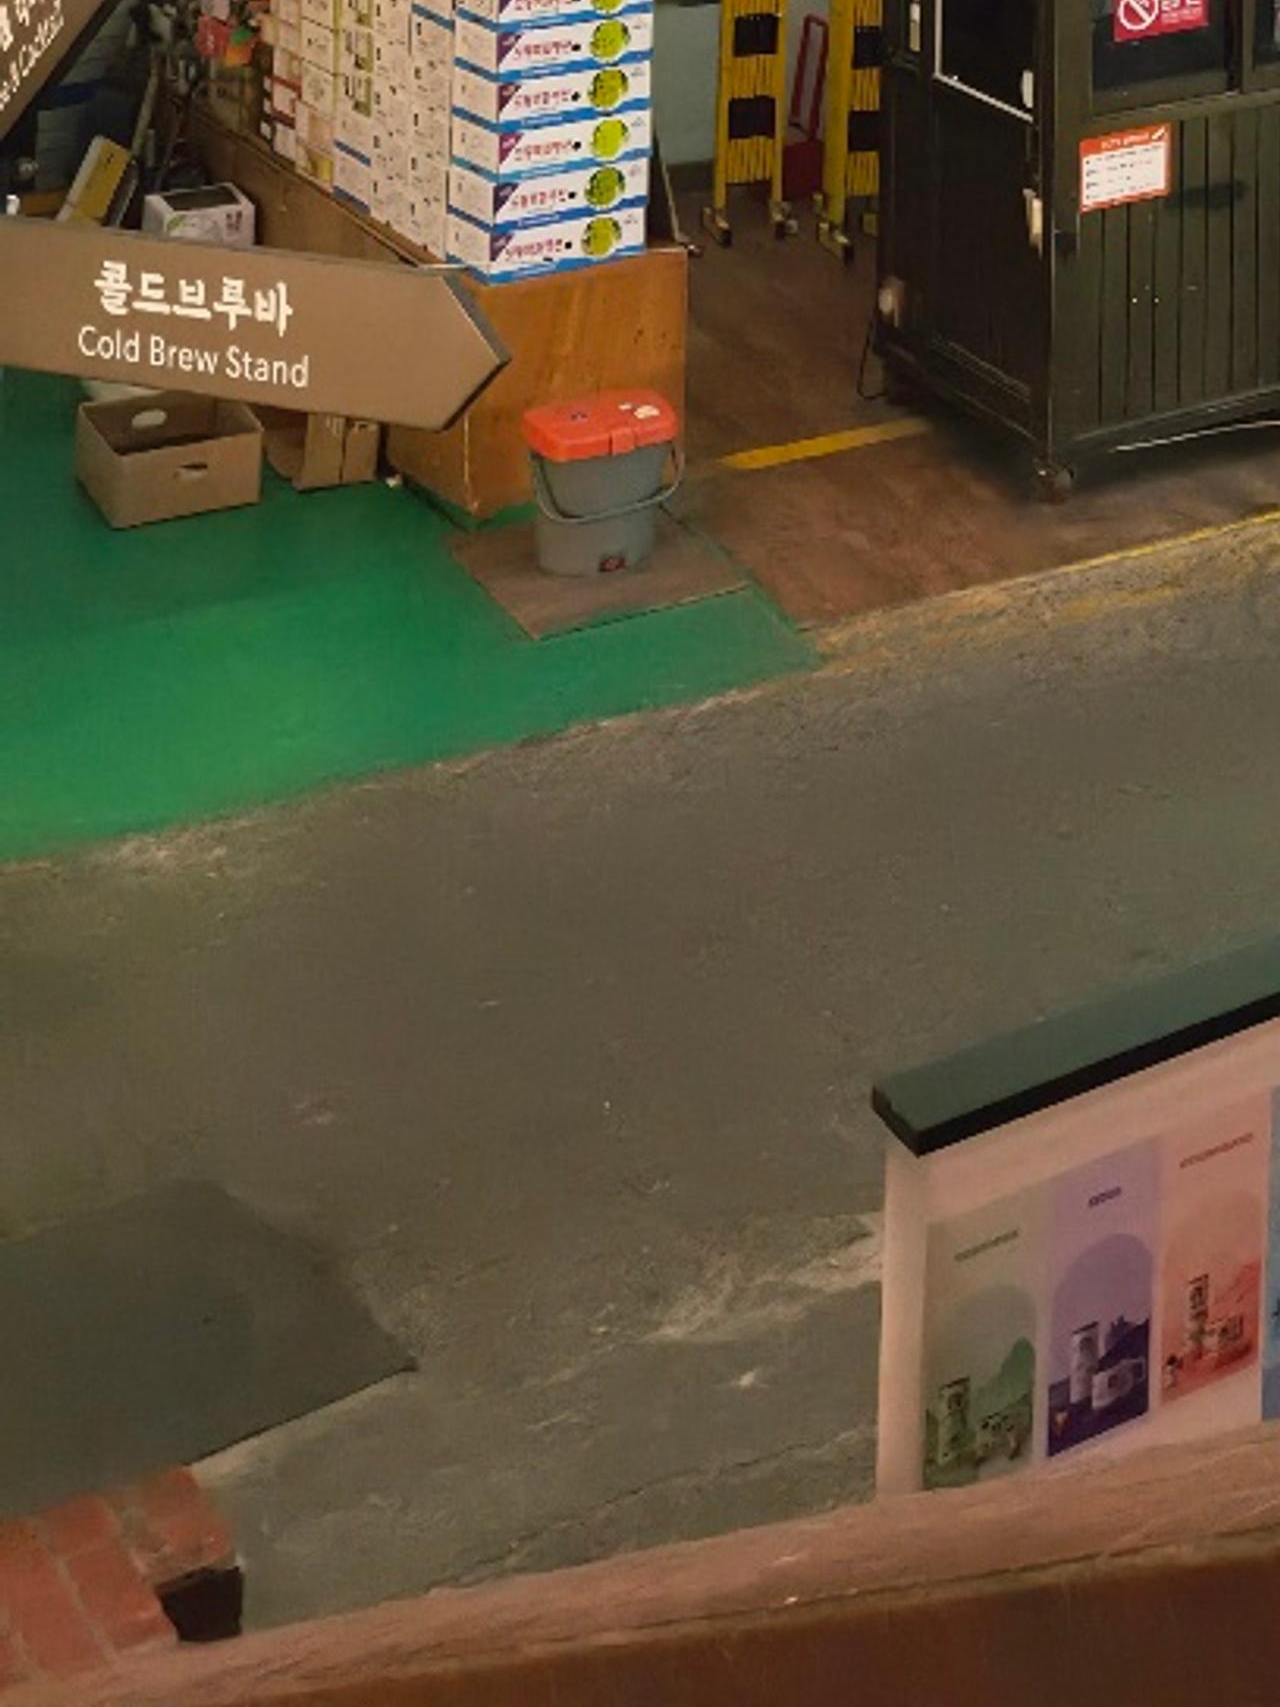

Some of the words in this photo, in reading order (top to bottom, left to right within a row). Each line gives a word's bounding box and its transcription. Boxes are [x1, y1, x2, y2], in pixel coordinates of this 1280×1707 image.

[94, 260, 293, 337] 콜드브루바
[78, 326, 141, 364] Cold
[149, 335, 219, 375] Brew
[225, 345, 310, 388] Stand
